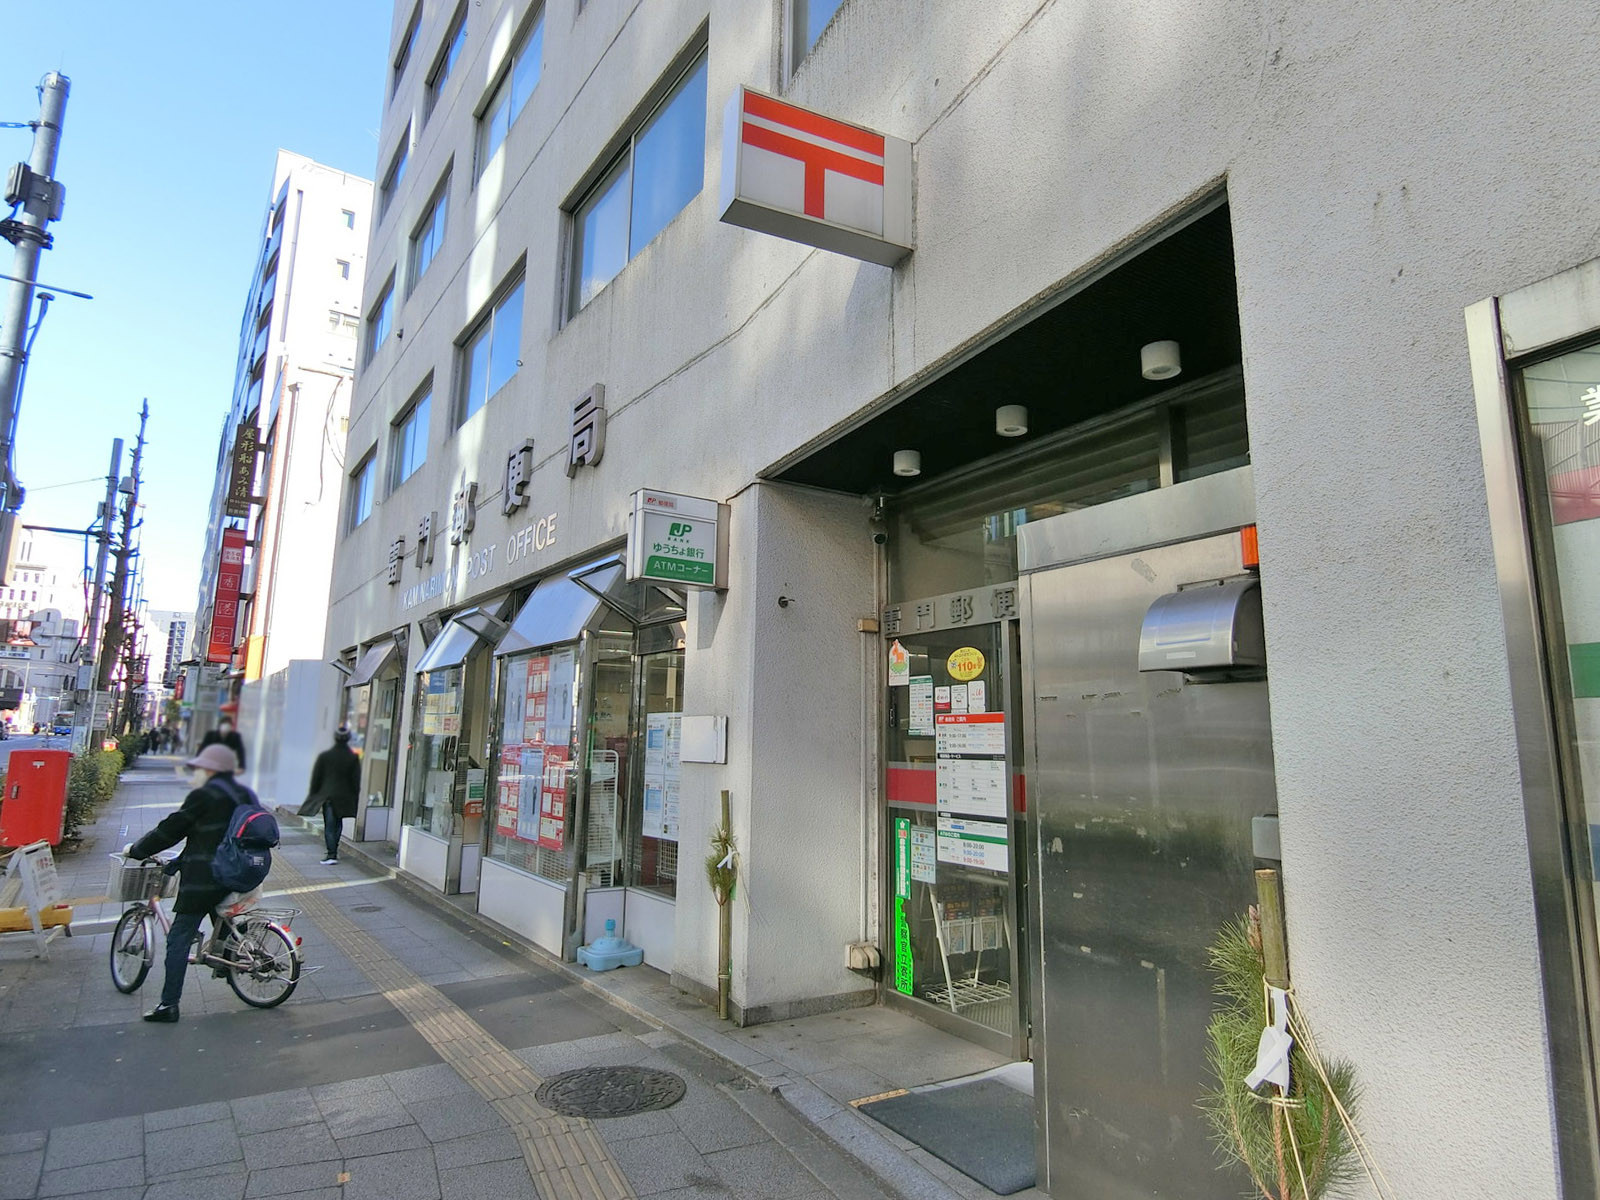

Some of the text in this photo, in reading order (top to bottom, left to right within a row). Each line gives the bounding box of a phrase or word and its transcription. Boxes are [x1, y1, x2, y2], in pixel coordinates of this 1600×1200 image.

[388, 382, 607, 586] 雷門郵便局
[669, 522, 692, 537] JP
[467, 544, 497, 580] POST
[506, 513, 559, 565] OFFICE
[653, 542, 705, 559] ゆうちょ銀行
[653, 560, 709, 574] ATMコーナー
